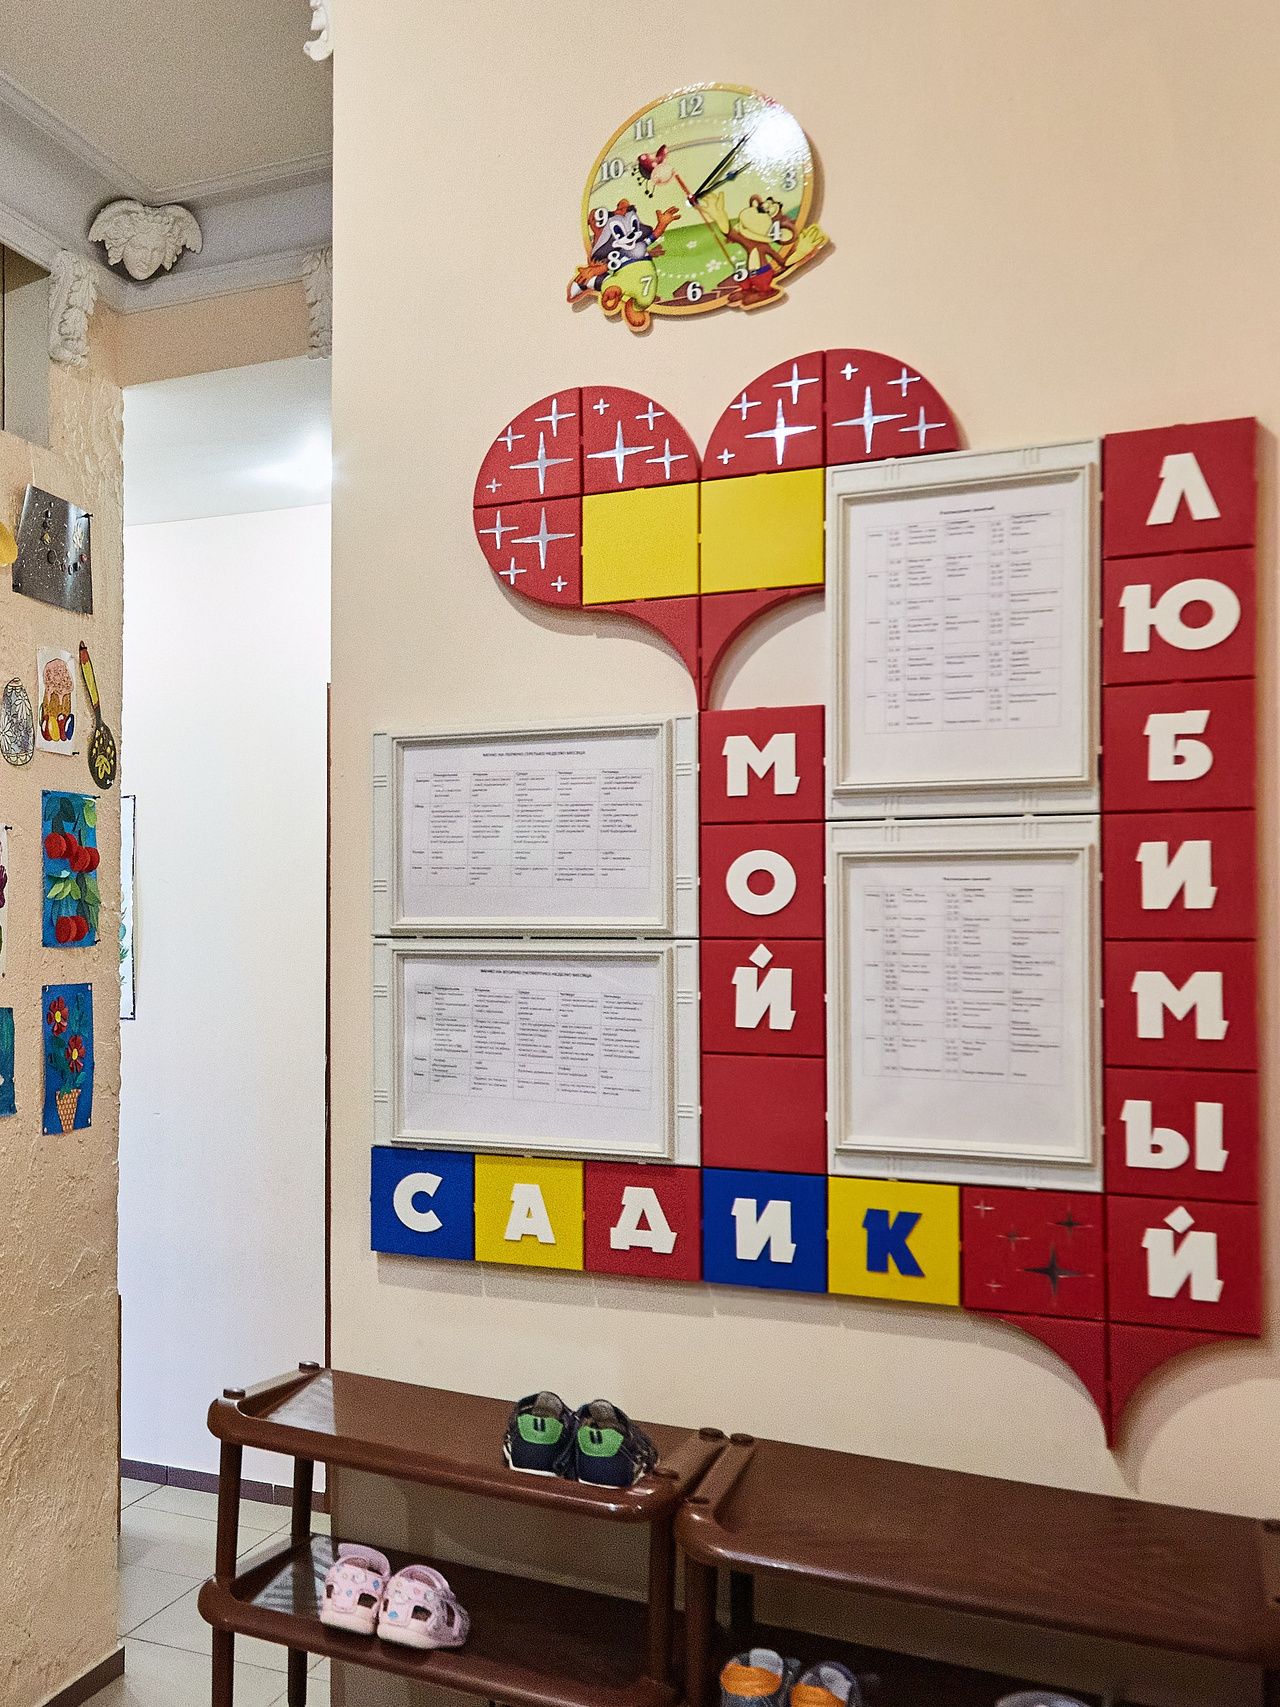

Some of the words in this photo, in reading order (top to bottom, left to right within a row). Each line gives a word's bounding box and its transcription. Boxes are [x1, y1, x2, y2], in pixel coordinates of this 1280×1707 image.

[679, 96, 703, 119] 12
[734, 99, 744, 119] 1
[634, 119, 655, 141] 11
[600, 158, 625, 181] 10
[782, 169, 798, 191] 3
[594, 207, 609, 228] 9
[768, 221, 783, 242] 4
[607, 250, 622, 270] 8
[734, 261, 748, 282] 5
[640, 277, 654, 296] 7
[686, 281, 702, 301] 6
[723, 733, 800, 1030] МОЙ
[1120, 453, 1240, 1302] ЛЮБИМЫЙ
[393, 1172, 922, 1275] САДИК
